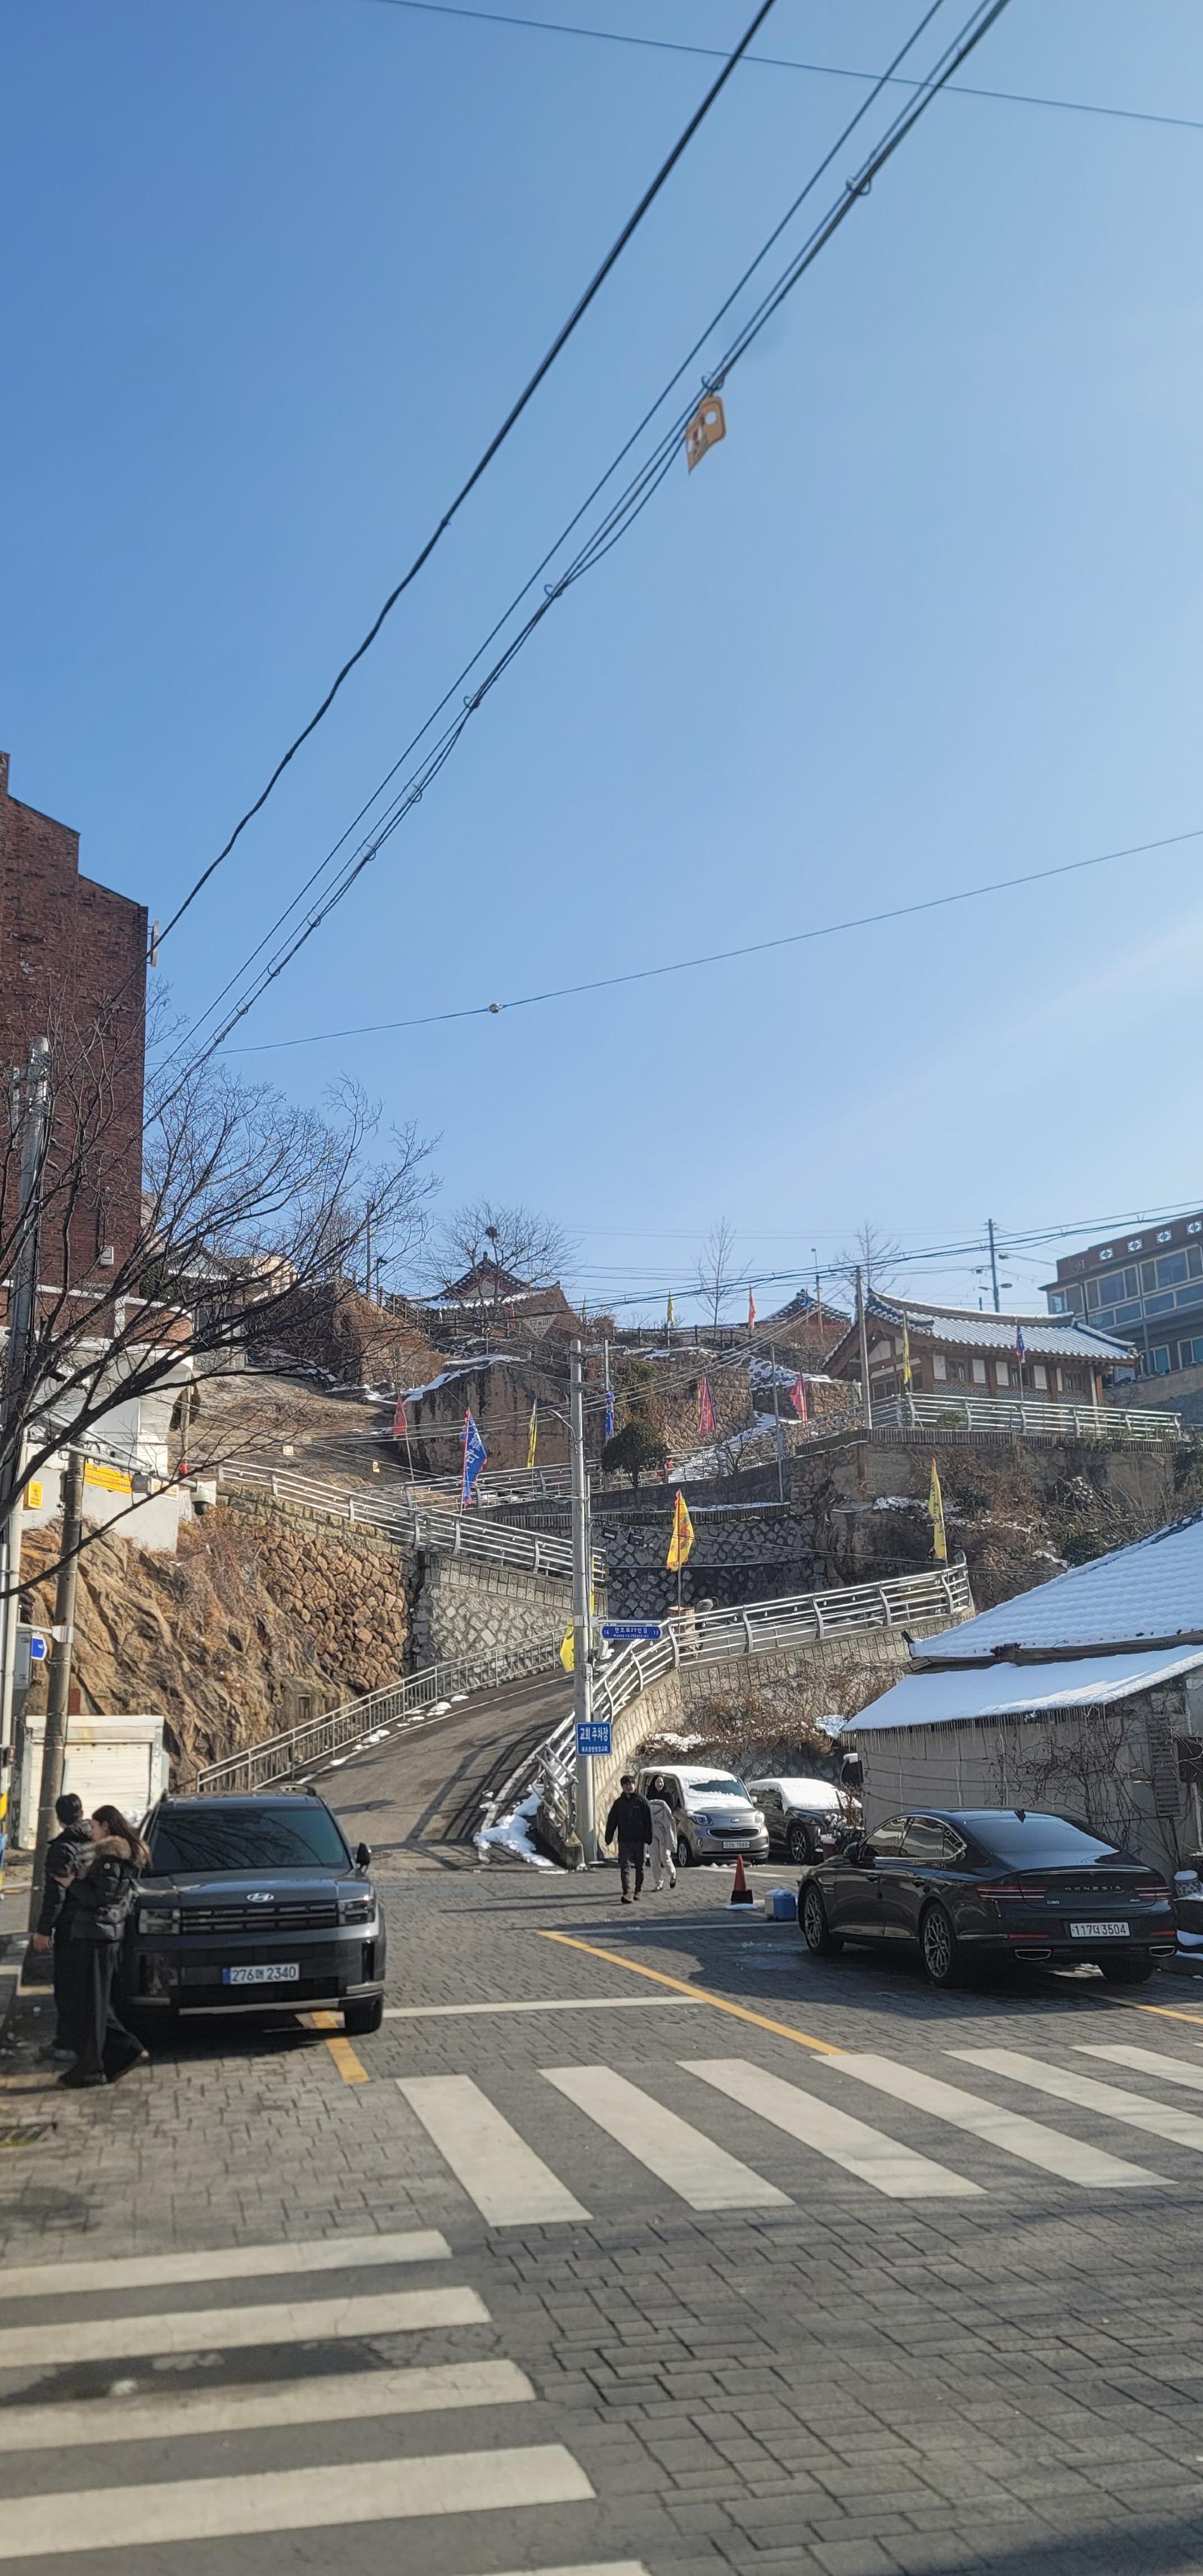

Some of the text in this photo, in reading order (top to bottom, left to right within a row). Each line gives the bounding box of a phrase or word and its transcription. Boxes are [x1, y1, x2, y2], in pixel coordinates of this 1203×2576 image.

[580, 1726, 608, 1742] 교회 주차장
[1074, 1924, 1126, 1936] 117더 3504
[266, 1966, 296, 1981] 2340
